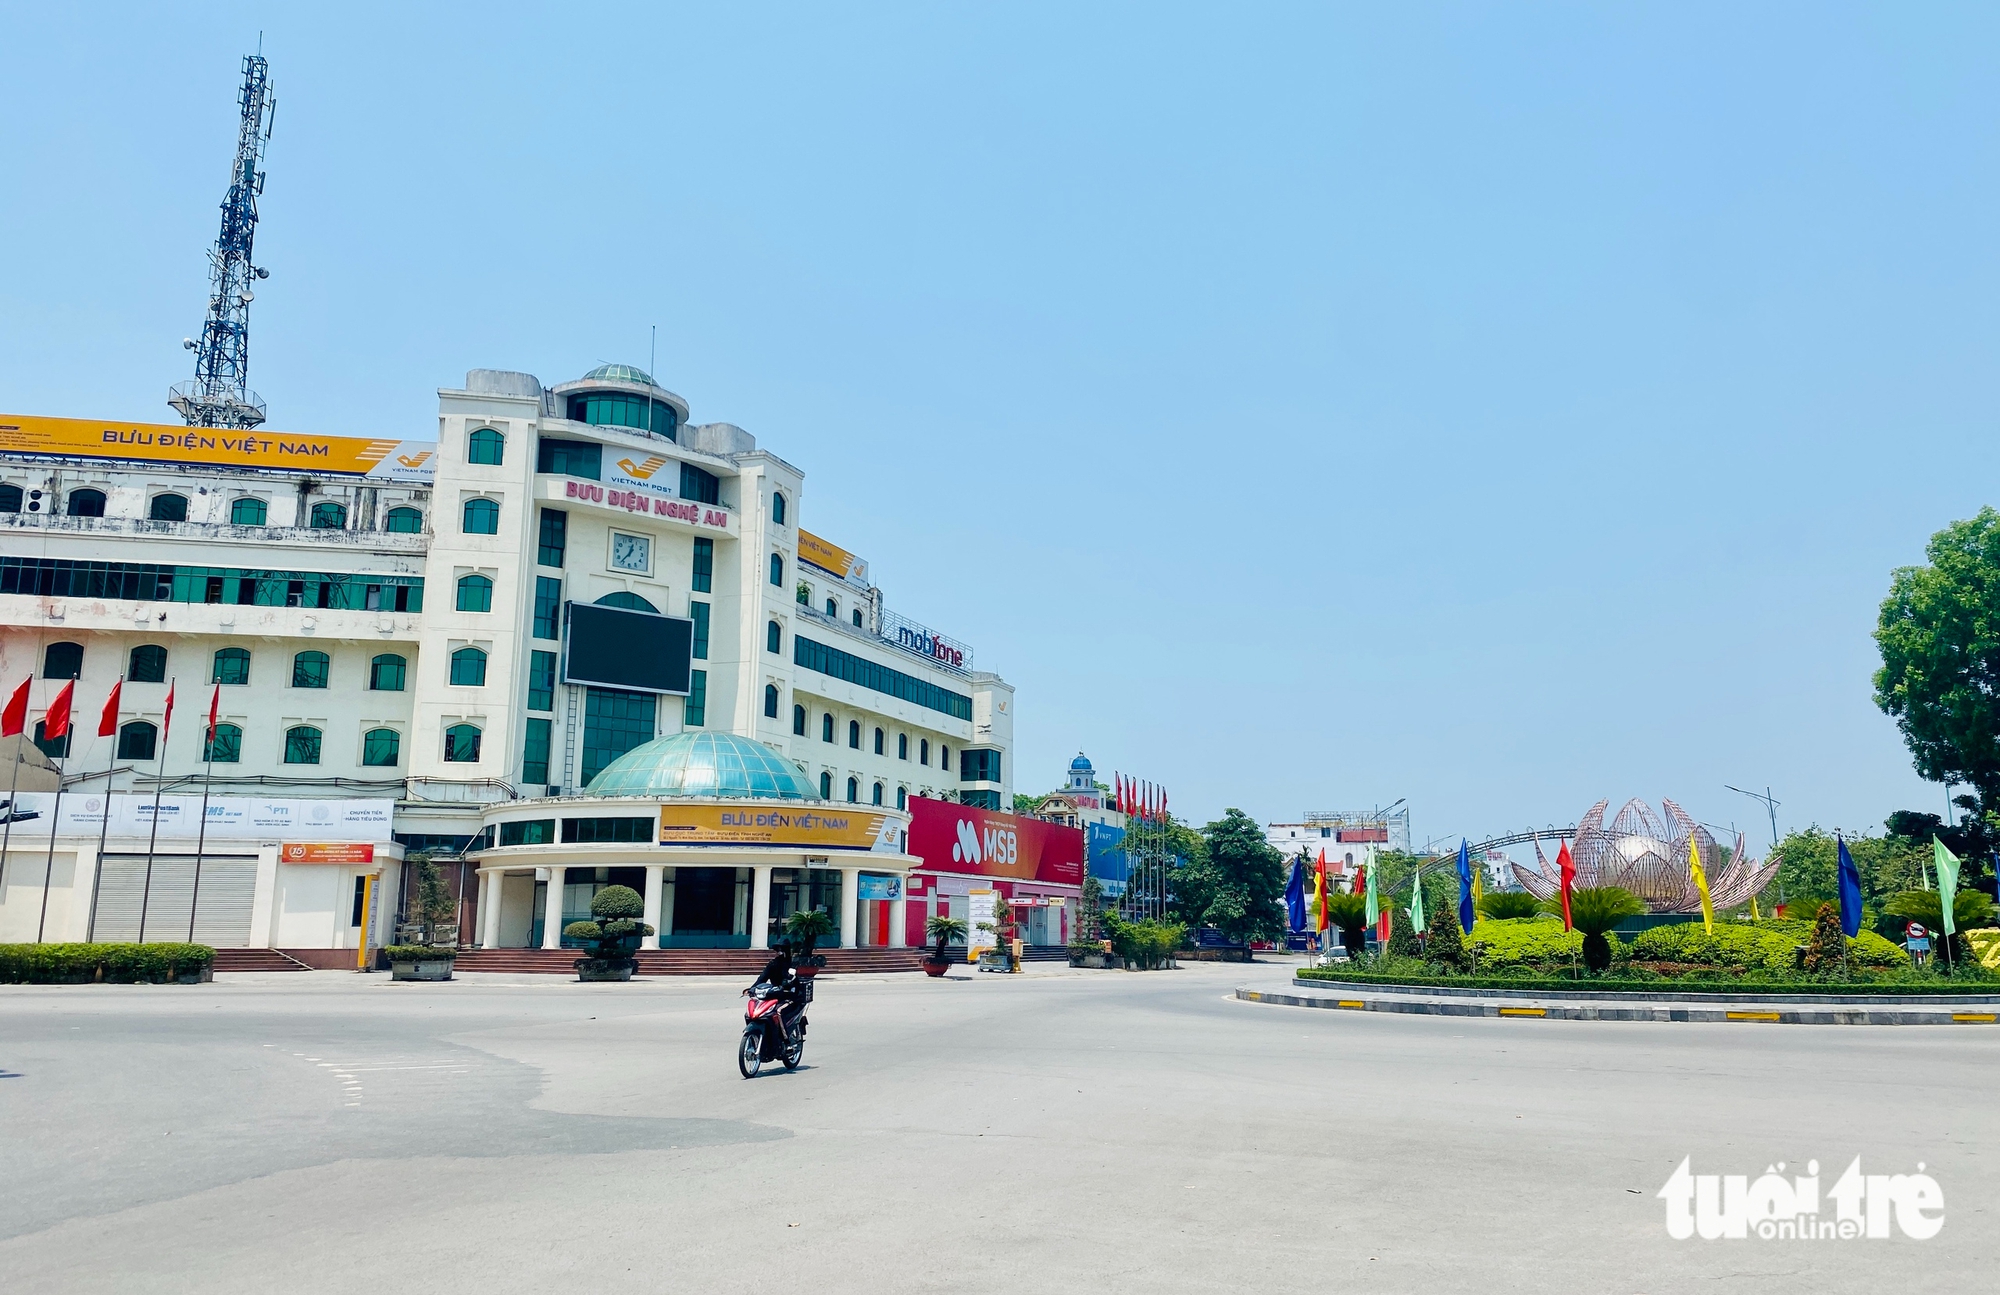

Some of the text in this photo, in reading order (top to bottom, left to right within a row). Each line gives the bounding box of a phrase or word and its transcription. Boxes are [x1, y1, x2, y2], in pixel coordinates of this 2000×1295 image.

[102, 429, 153, 445] BƯU
[157, 432, 215, 449] ĐIỆN
[221, 436, 273, 455] VIỆT
[279, 442, 329, 457] NAM
[611, 476, 672, 493] VIETNAM POST
[566, 481, 727, 528] BƯU ĐIỆN NGHỆ AN
[899, 626, 963, 667] mobifone
[273, 807, 288, 815] PTI
[721, 811, 848, 831] BƯU ĐIỆN VIỆT NAM
[291, 846, 303, 855] 15
[983, 827, 1017, 864] MSB
